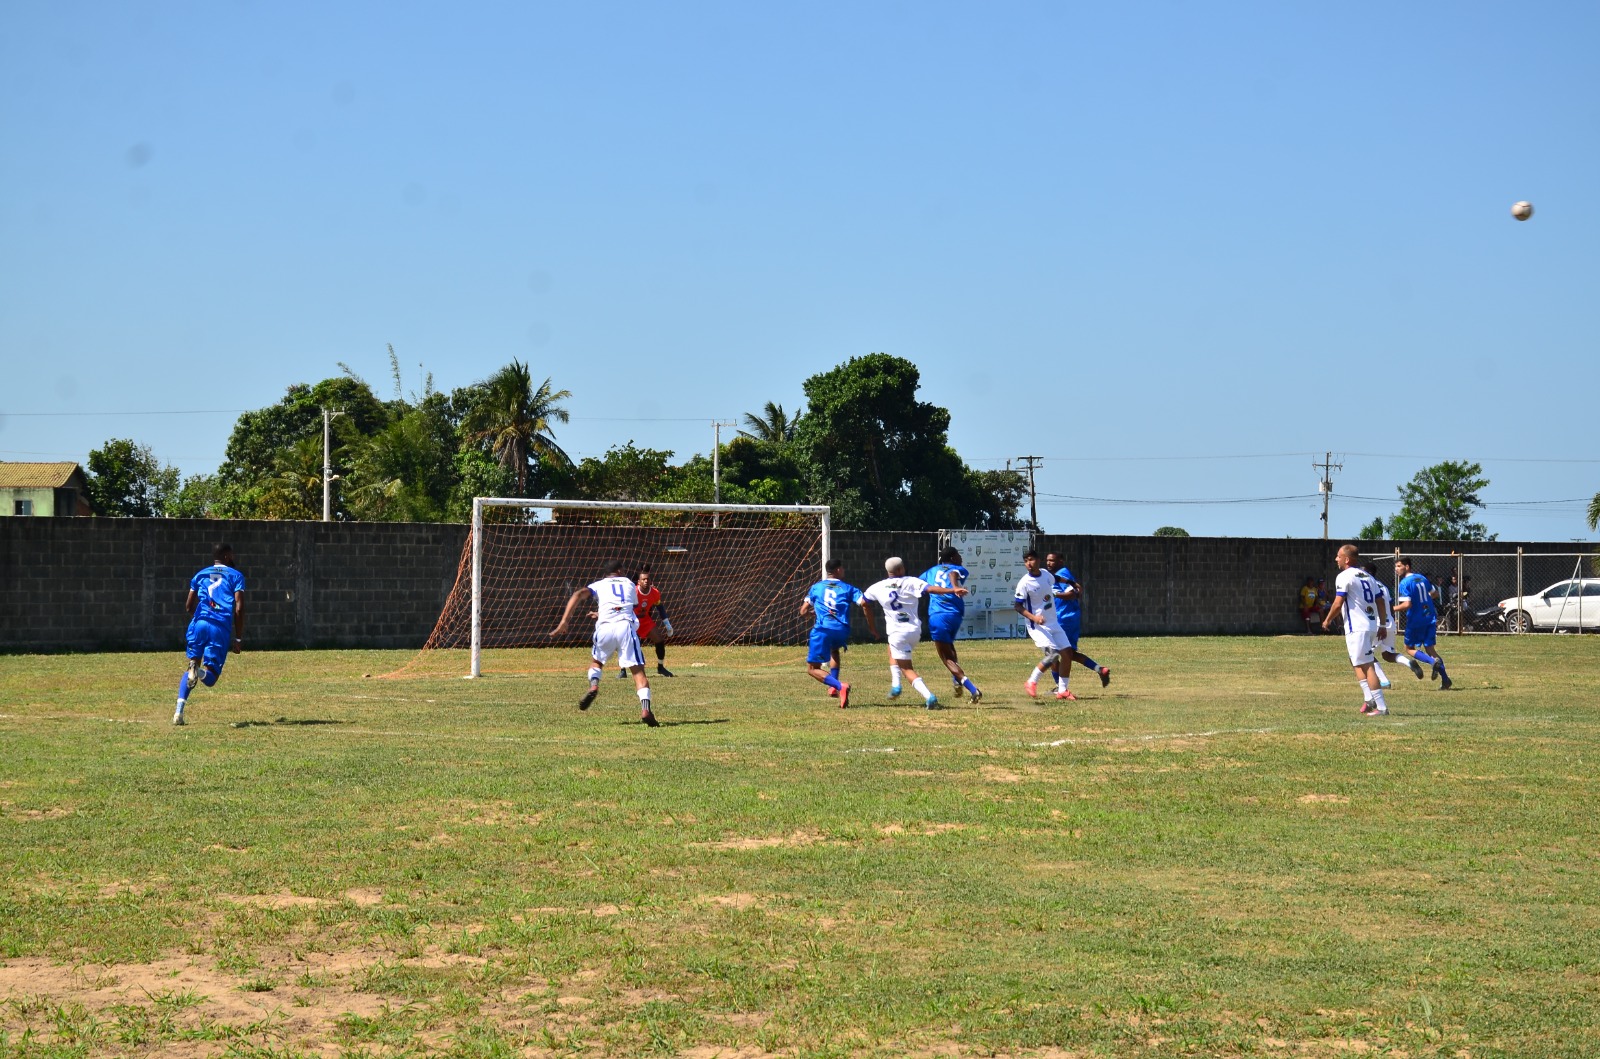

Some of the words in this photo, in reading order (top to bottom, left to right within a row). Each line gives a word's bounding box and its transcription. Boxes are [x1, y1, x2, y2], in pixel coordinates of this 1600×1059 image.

[208, 573, 222, 598] 7
[611, 583, 625, 602] 4
[1360, 580, 1374, 603] 8
[1416, 582, 1428, 602] 11
[823, 588, 837, 609] 6
[888, 591, 902, 611] 2
